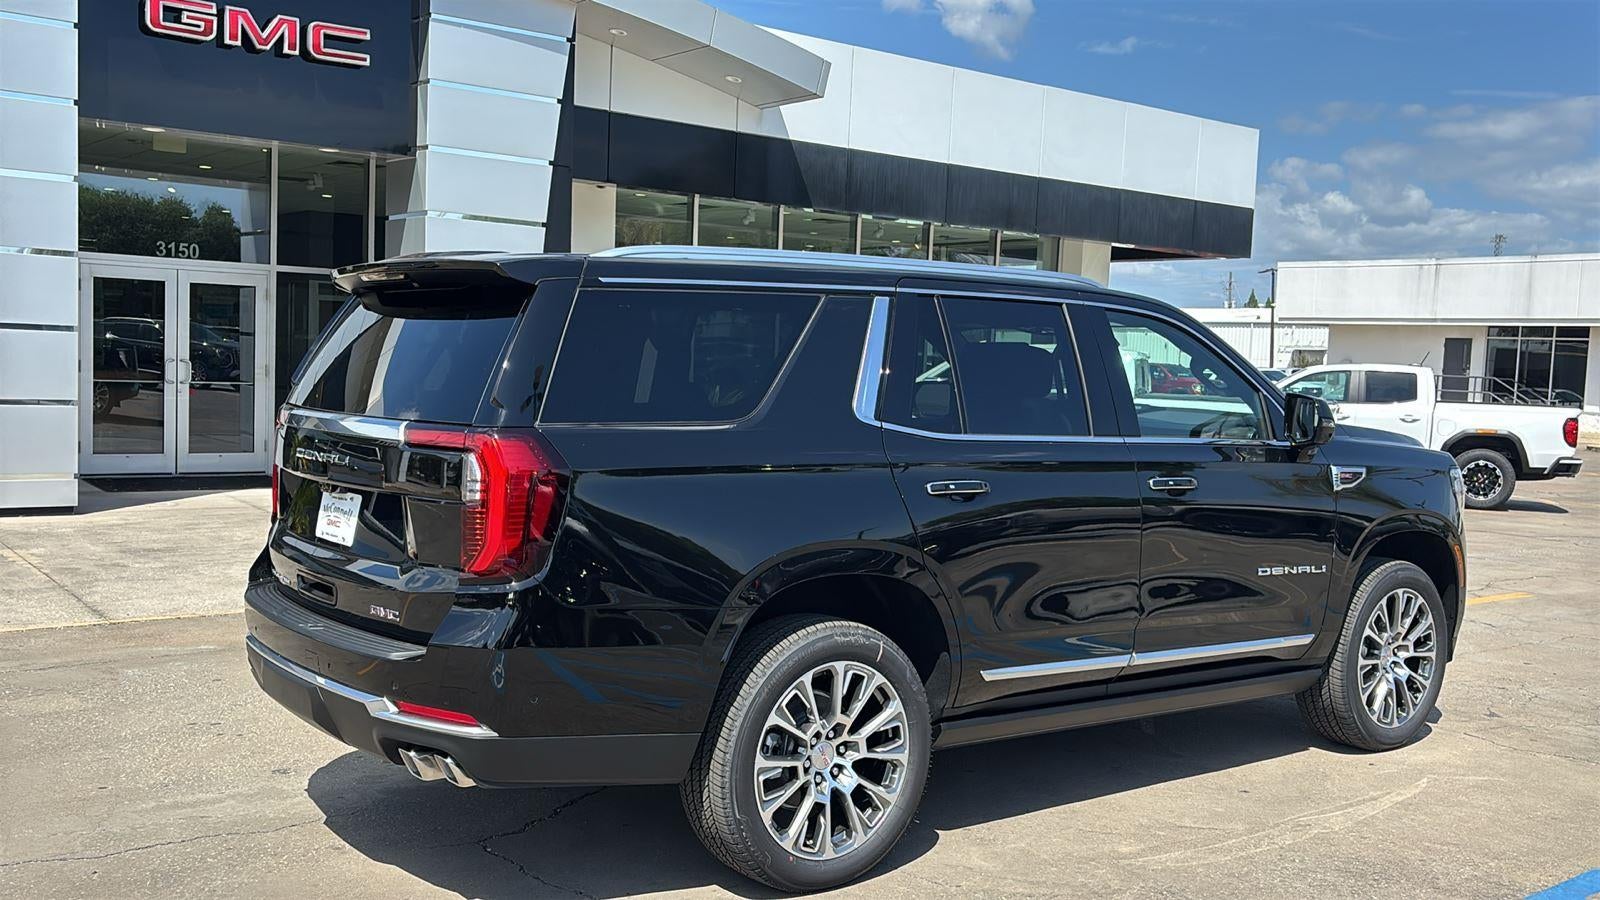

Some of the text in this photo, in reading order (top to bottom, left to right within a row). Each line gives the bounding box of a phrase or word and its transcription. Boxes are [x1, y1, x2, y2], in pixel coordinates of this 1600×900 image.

[145, 0, 371, 67] GMC
[156, 241, 200, 259] 3150
[326, 518, 342, 529] GMC
[1257, 564, 1327, 577] DENALI
[368, 604, 400, 622] GMC
